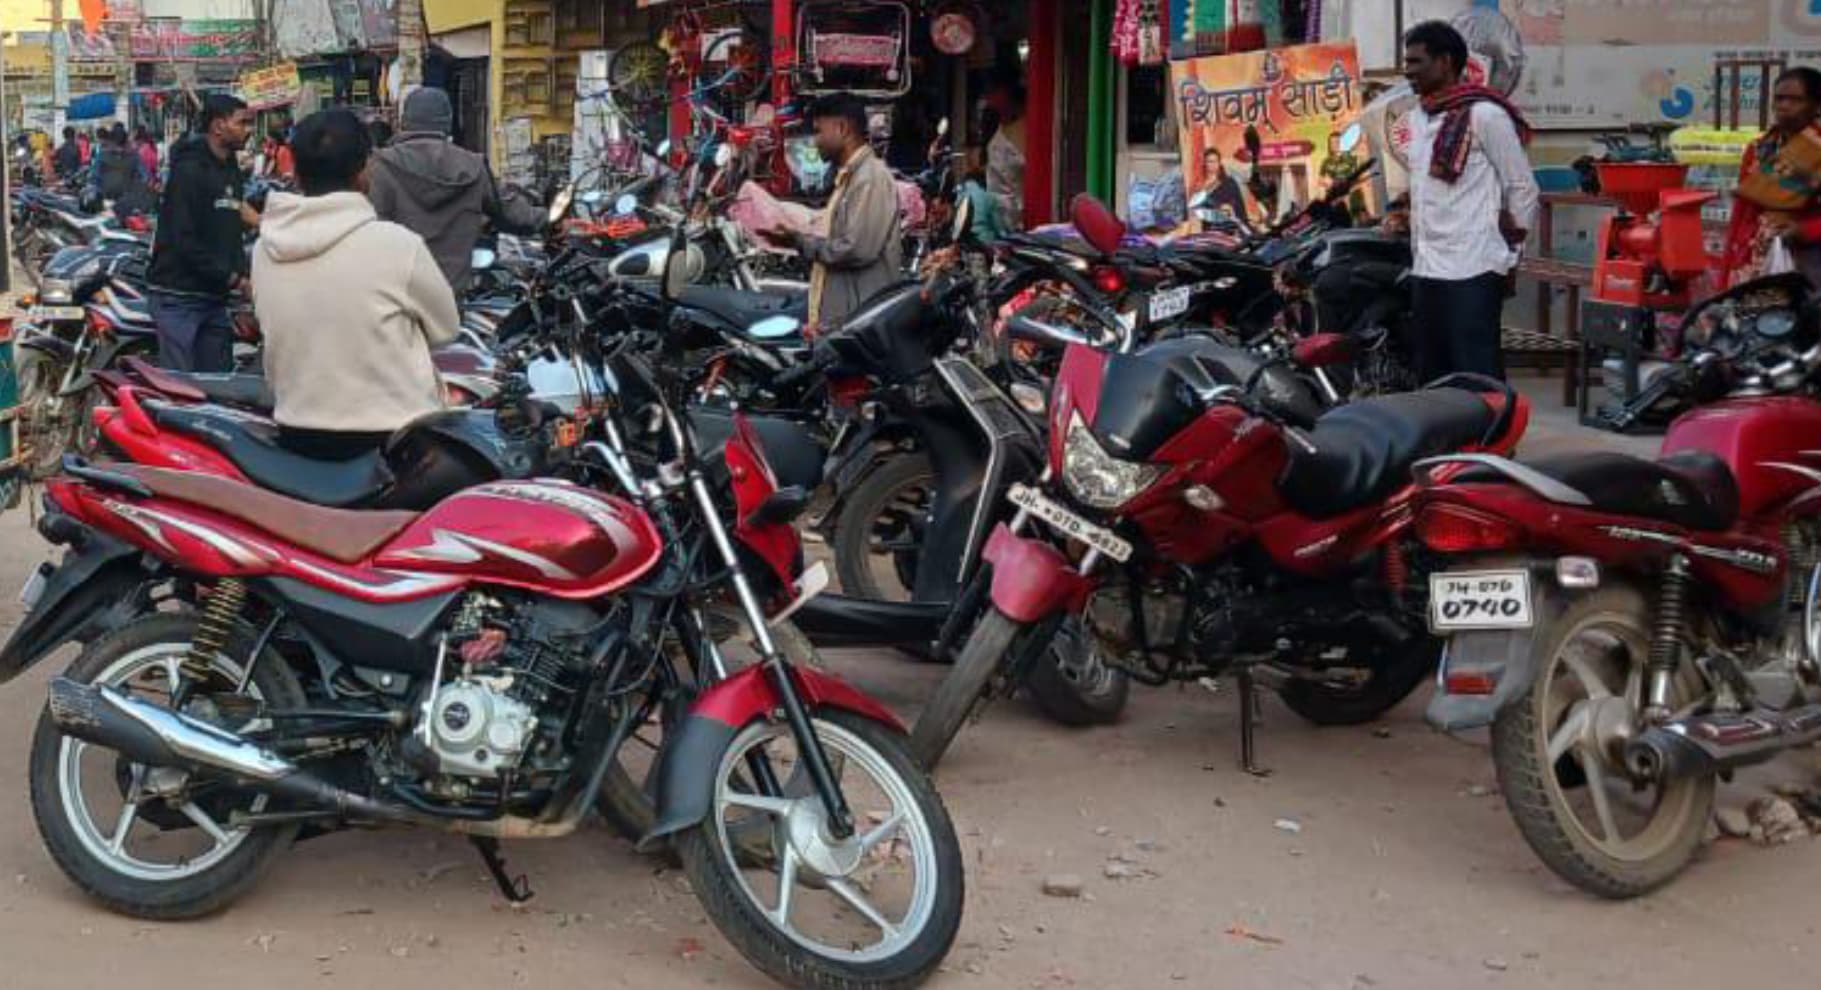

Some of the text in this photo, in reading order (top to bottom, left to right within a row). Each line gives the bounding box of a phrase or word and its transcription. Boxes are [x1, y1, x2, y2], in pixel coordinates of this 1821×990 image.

[1180, 60, 1355, 134] शिवम् साड़ी
[1442, 598, 1522, 619] 0740
